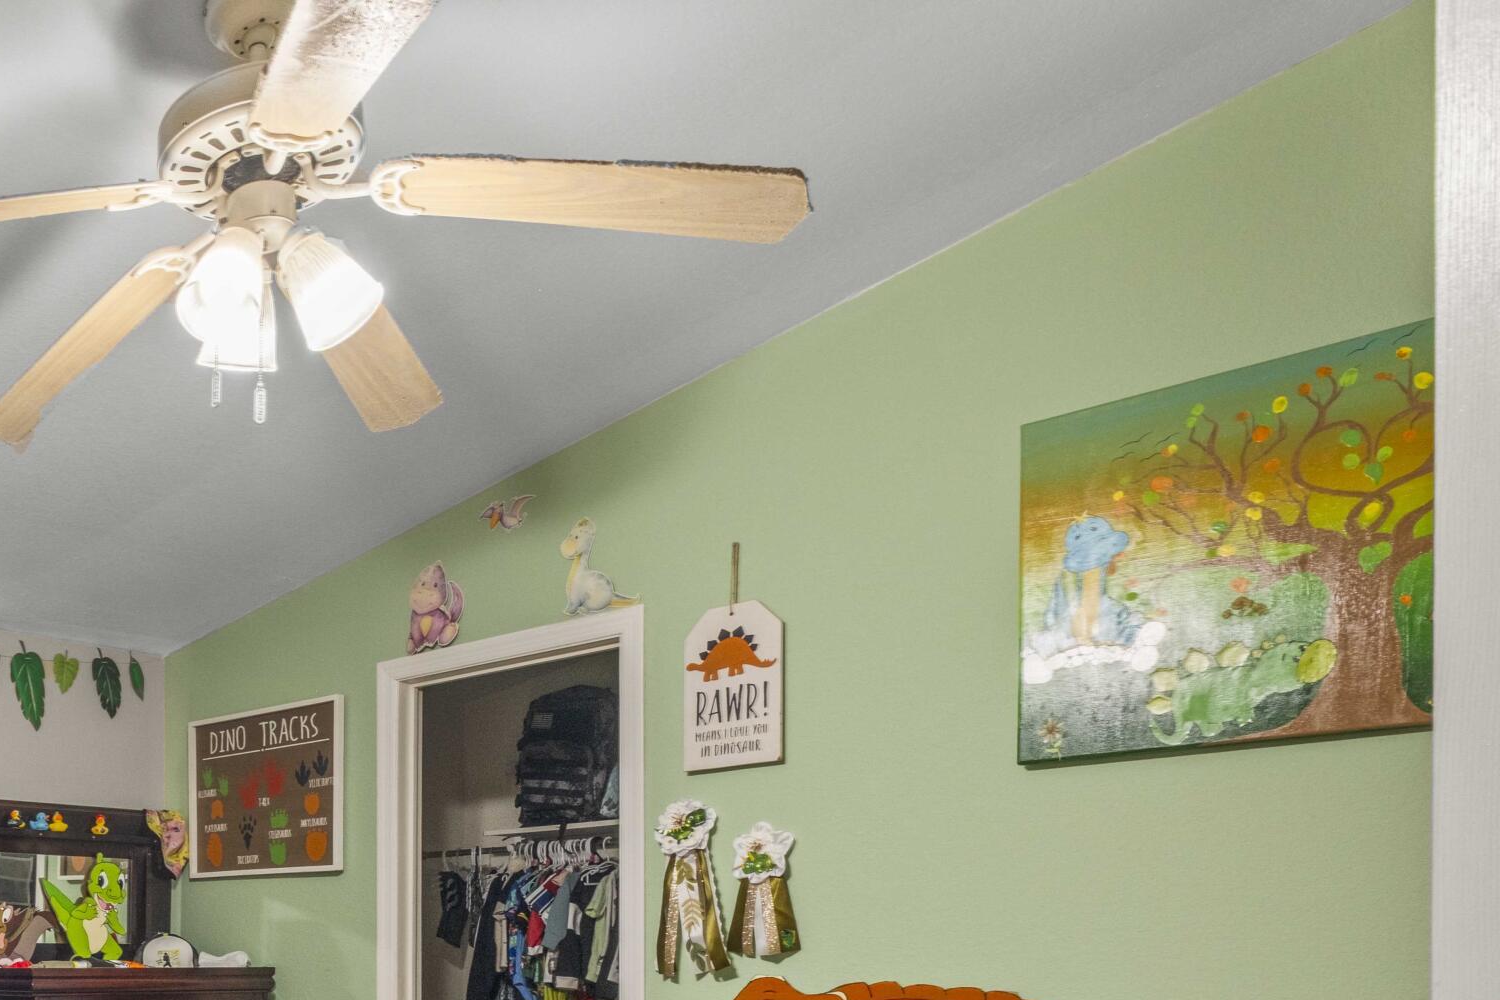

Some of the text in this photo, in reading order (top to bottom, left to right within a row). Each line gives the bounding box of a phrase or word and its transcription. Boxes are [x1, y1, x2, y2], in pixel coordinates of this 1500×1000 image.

[696, 681, 768, 727] RAWR!
[210, 713, 318, 754] DINO TRACKS
[695, 729, 721, 743] MEANS
[729, 726, 749, 738] LOVE
[753, 723, 768, 734] YOU
